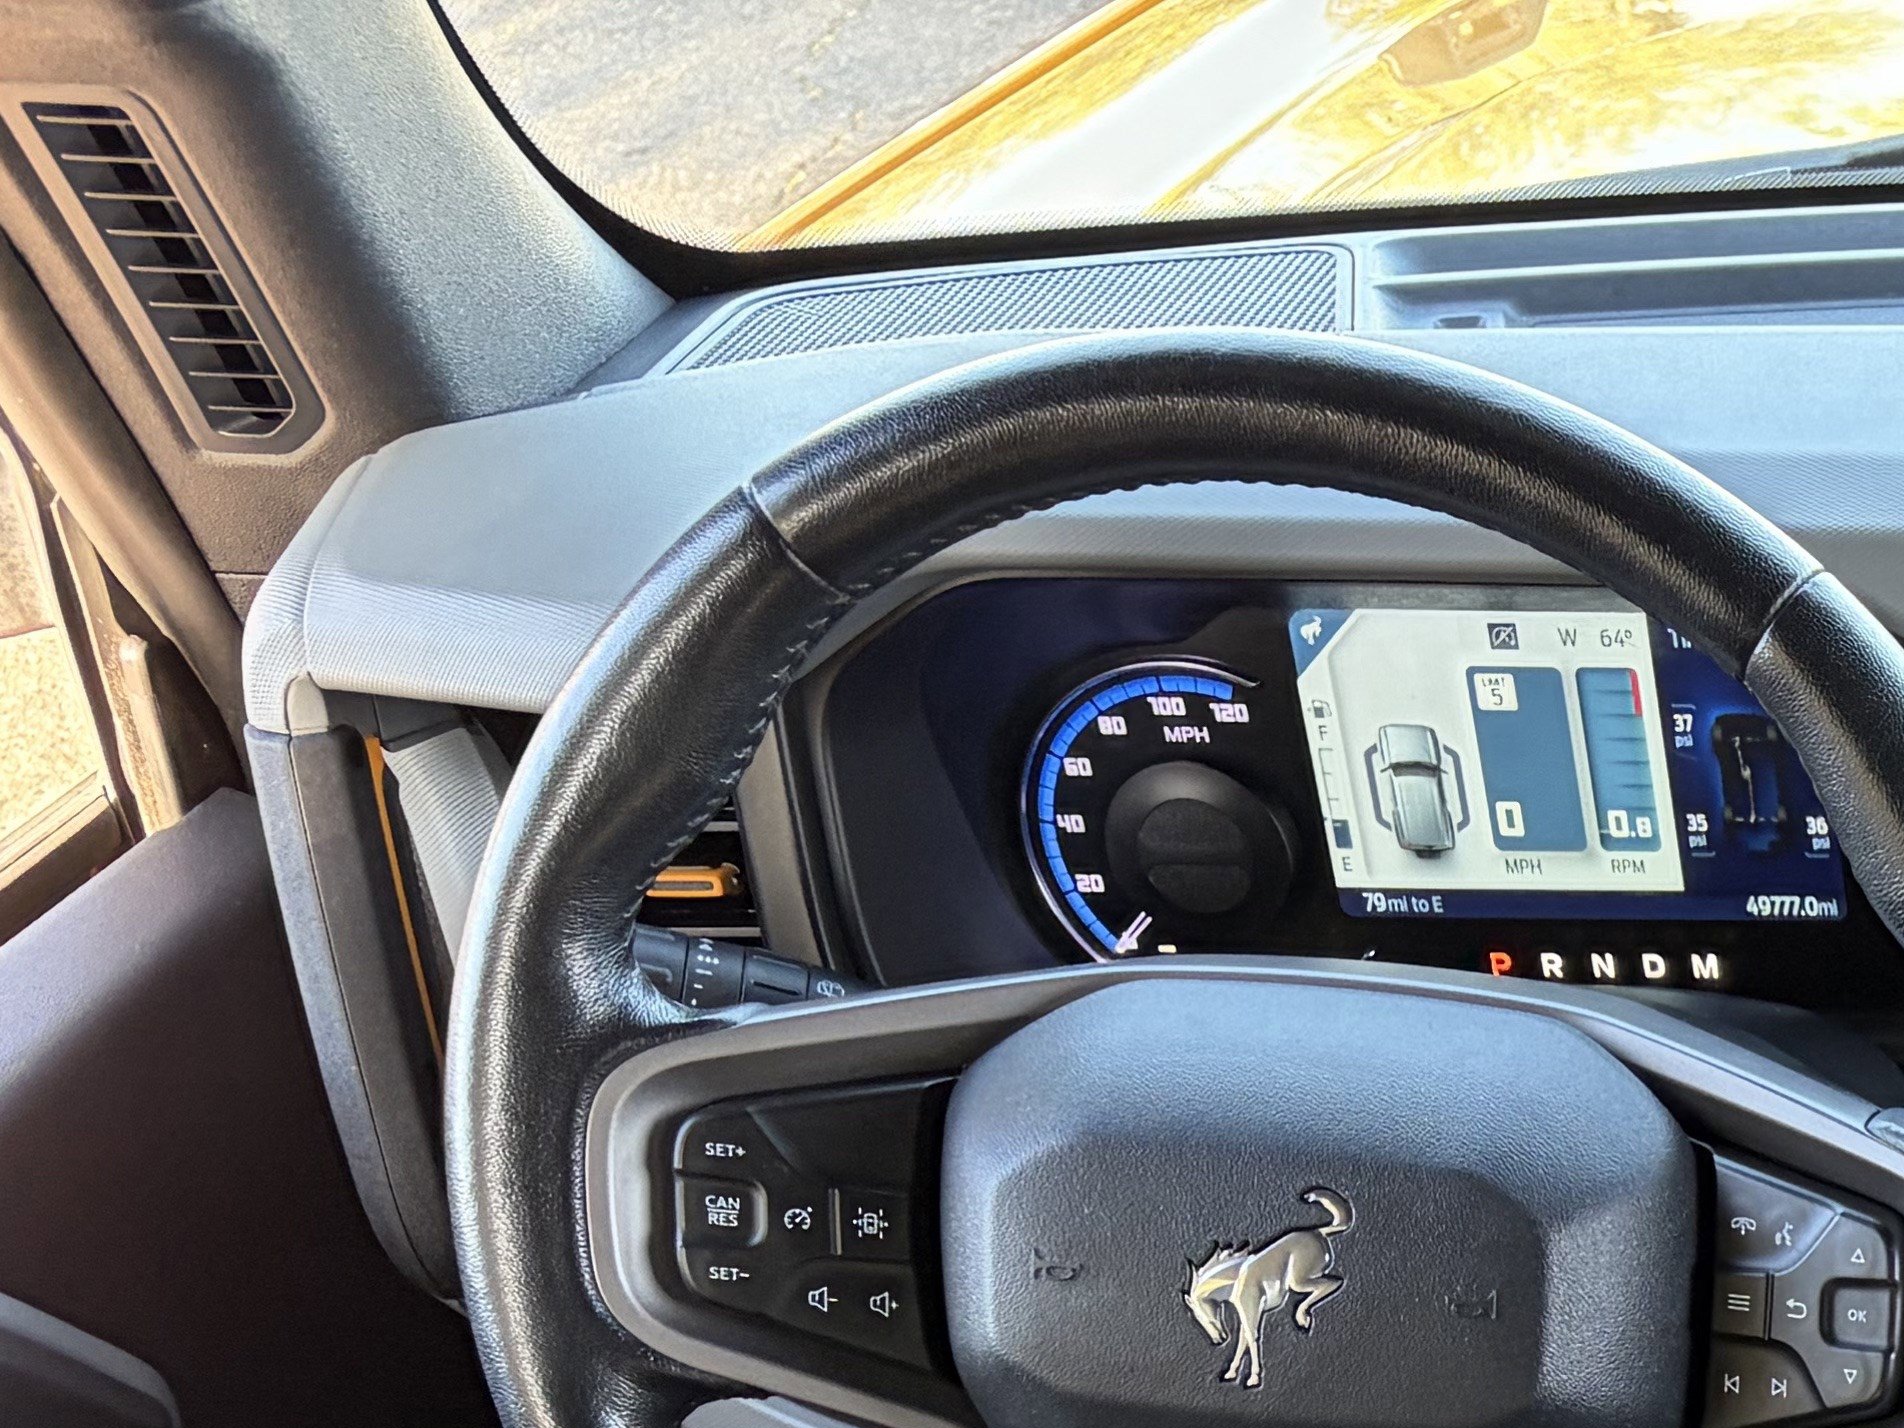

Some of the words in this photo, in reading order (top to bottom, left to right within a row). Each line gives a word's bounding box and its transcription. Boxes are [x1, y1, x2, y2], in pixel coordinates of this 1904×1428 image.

[1558, 628, 1577, 646] W
[1600, 629, 1633, 648] 64°
[1491, 688, 1503, 706] 5
[1147, 697, 1187, 716] 100
[1209, 703, 1250, 723] 120
[1098, 716, 1128, 736] 80
[1673, 714, 1694, 732] 37
[1163, 726, 1211, 744] MPH
[1318, 725, 1328, 741] F
[1063, 757, 1093, 777] 60
[1056, 814, 1086, 833] 40
[1495, 800, 1525, 837] 0
[1607, 809, 1653, 839] 0.8
[1686, 813, 1708, 832] 35
[1805, 816, 1829, 836] 36
[1343, 857, 1353, 872] E
[1505, 858, 1543, 876] MPH
[1611, 858, 1647, 874] RPM
[1075, 873, 1105, 893] 20
[1411, 896, 1430, 913] to
[1431, 896, 1444, 913] E
[1489, 951, 1513, 977] P
[1542, 952, 1564, 978] R
[1592, 952, 1616, 979] N
[1642, 952, 1666, 979] D
[1690, 952, 1720, 980] M
[705, 1142, 746, 1157] SET+
[705, 1195, 740, 1210] CAN
[708, 1213, 739, 1227] RES
[1847, 1308, 1867, 1322] OK
